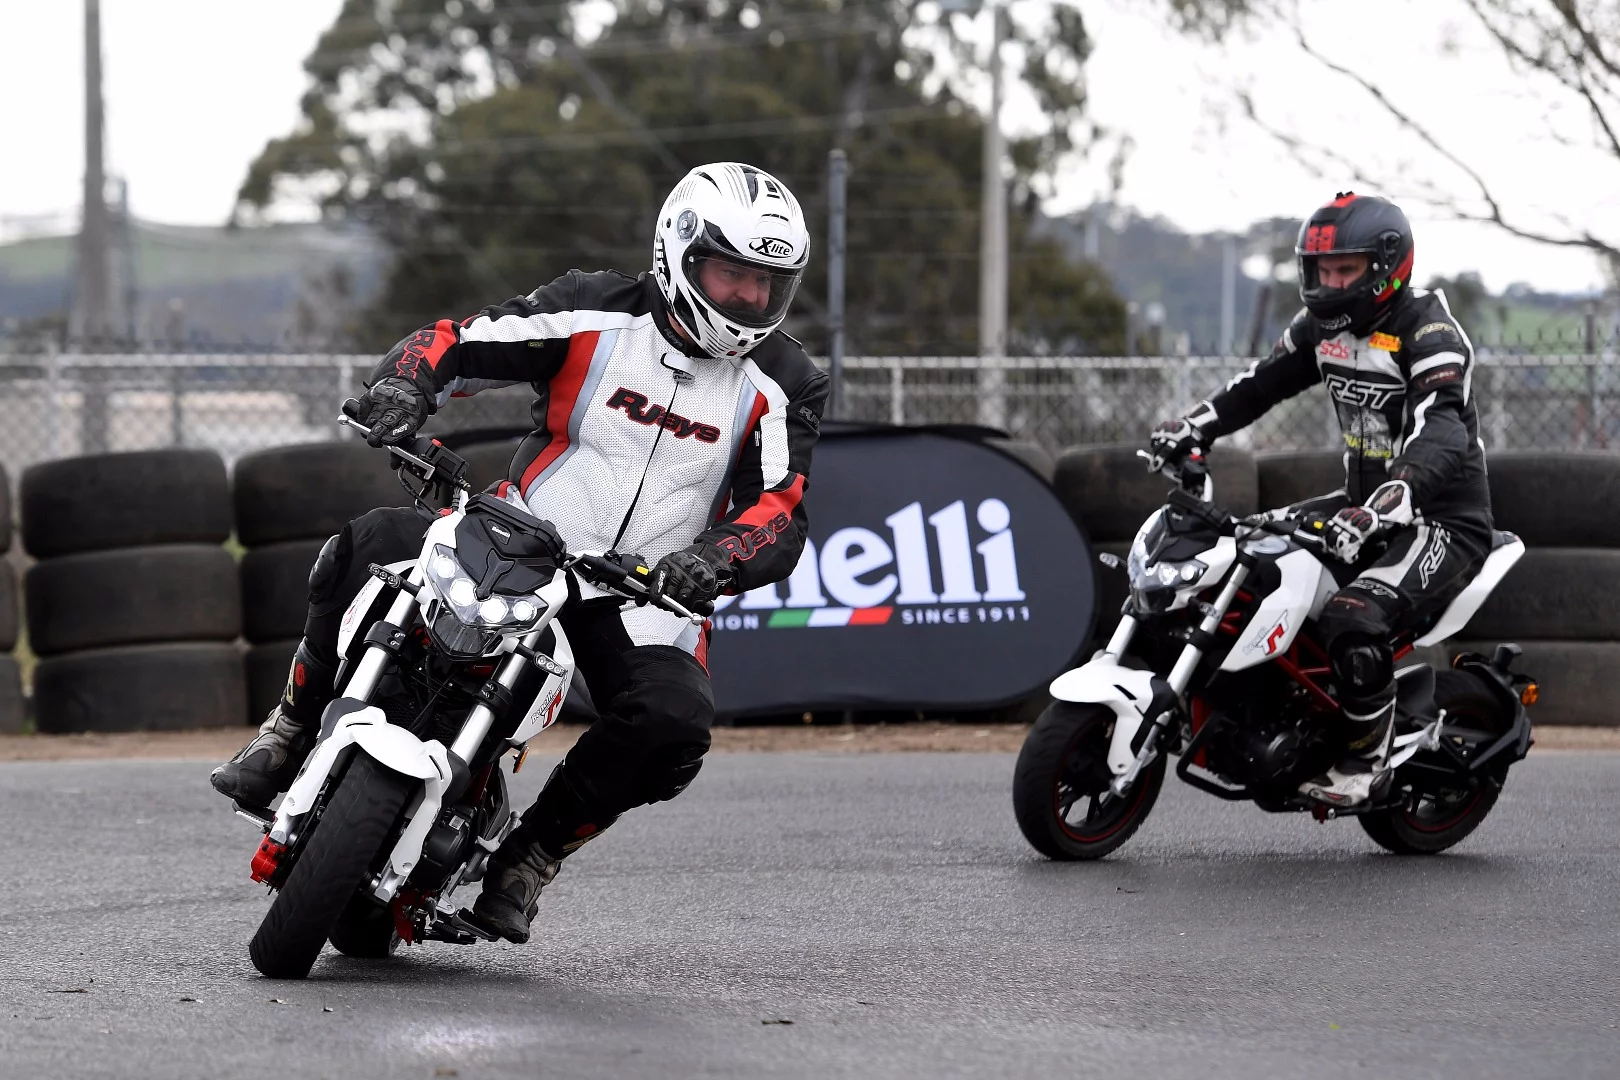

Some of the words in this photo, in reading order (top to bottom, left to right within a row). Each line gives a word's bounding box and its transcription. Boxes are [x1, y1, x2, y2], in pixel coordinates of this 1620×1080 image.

[755, 237, 790, 256] X-lite
[1325, 373, 1408, 410] RST
[712, 497, 1027, 613] nelli
[901, 607, 970, 625] SINCE
[976, 605, 1030, 623] 1911
